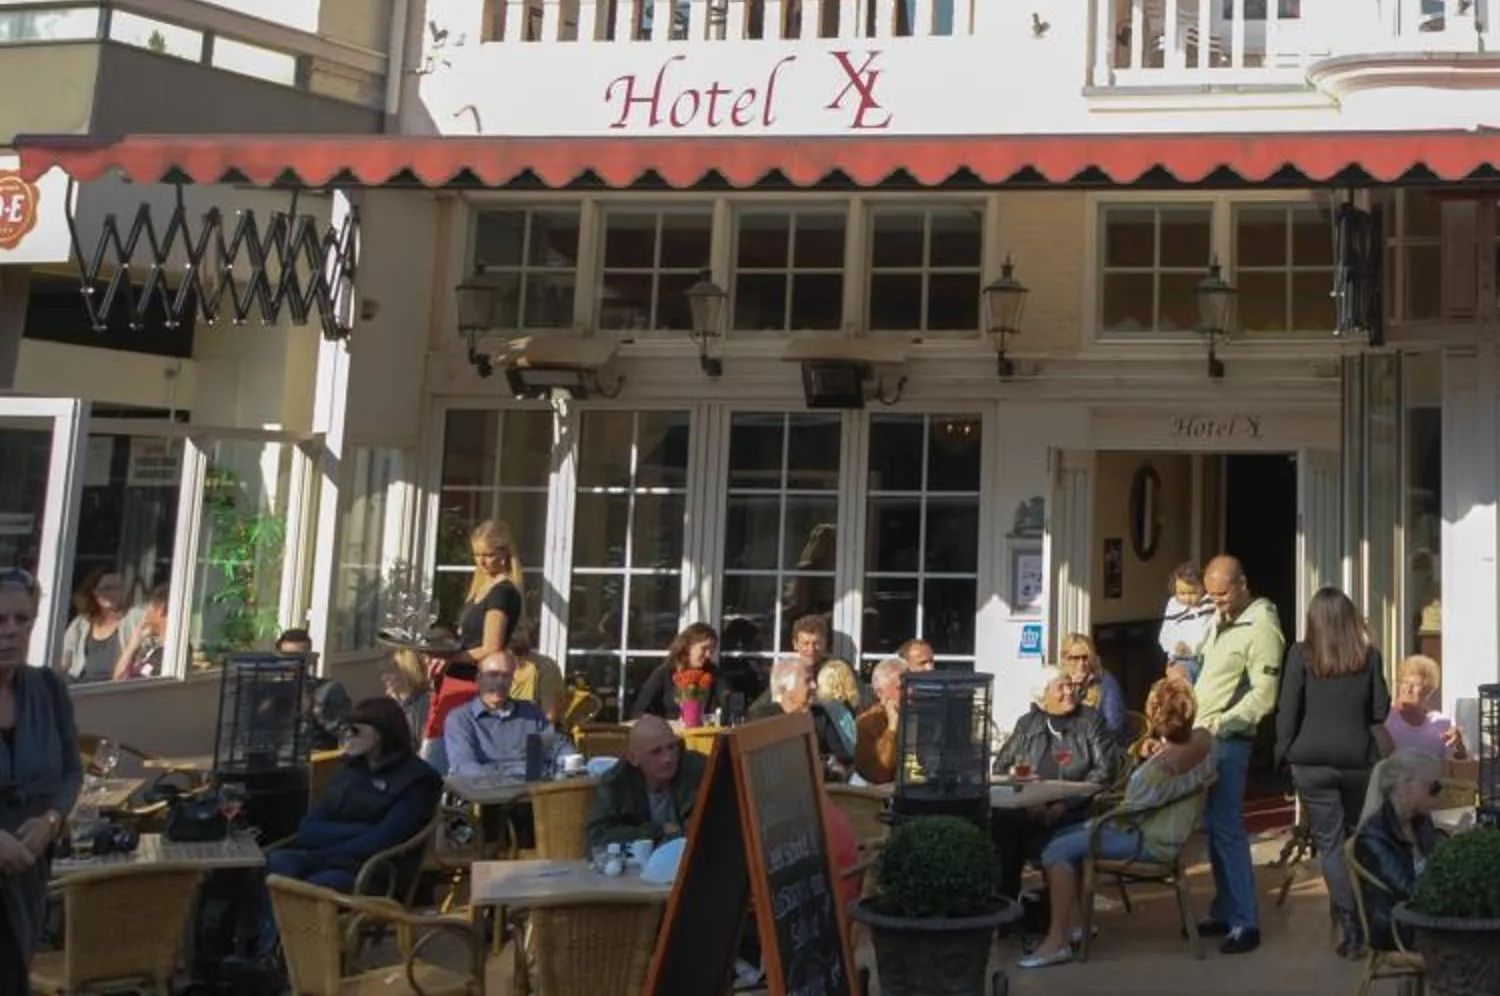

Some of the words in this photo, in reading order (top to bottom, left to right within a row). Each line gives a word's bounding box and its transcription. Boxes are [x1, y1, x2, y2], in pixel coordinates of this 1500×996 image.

[604, 54, 797, 129] Hotel
[824, 50, 893, 129] XL
[1171, 412, 1238, 438] Hotel
